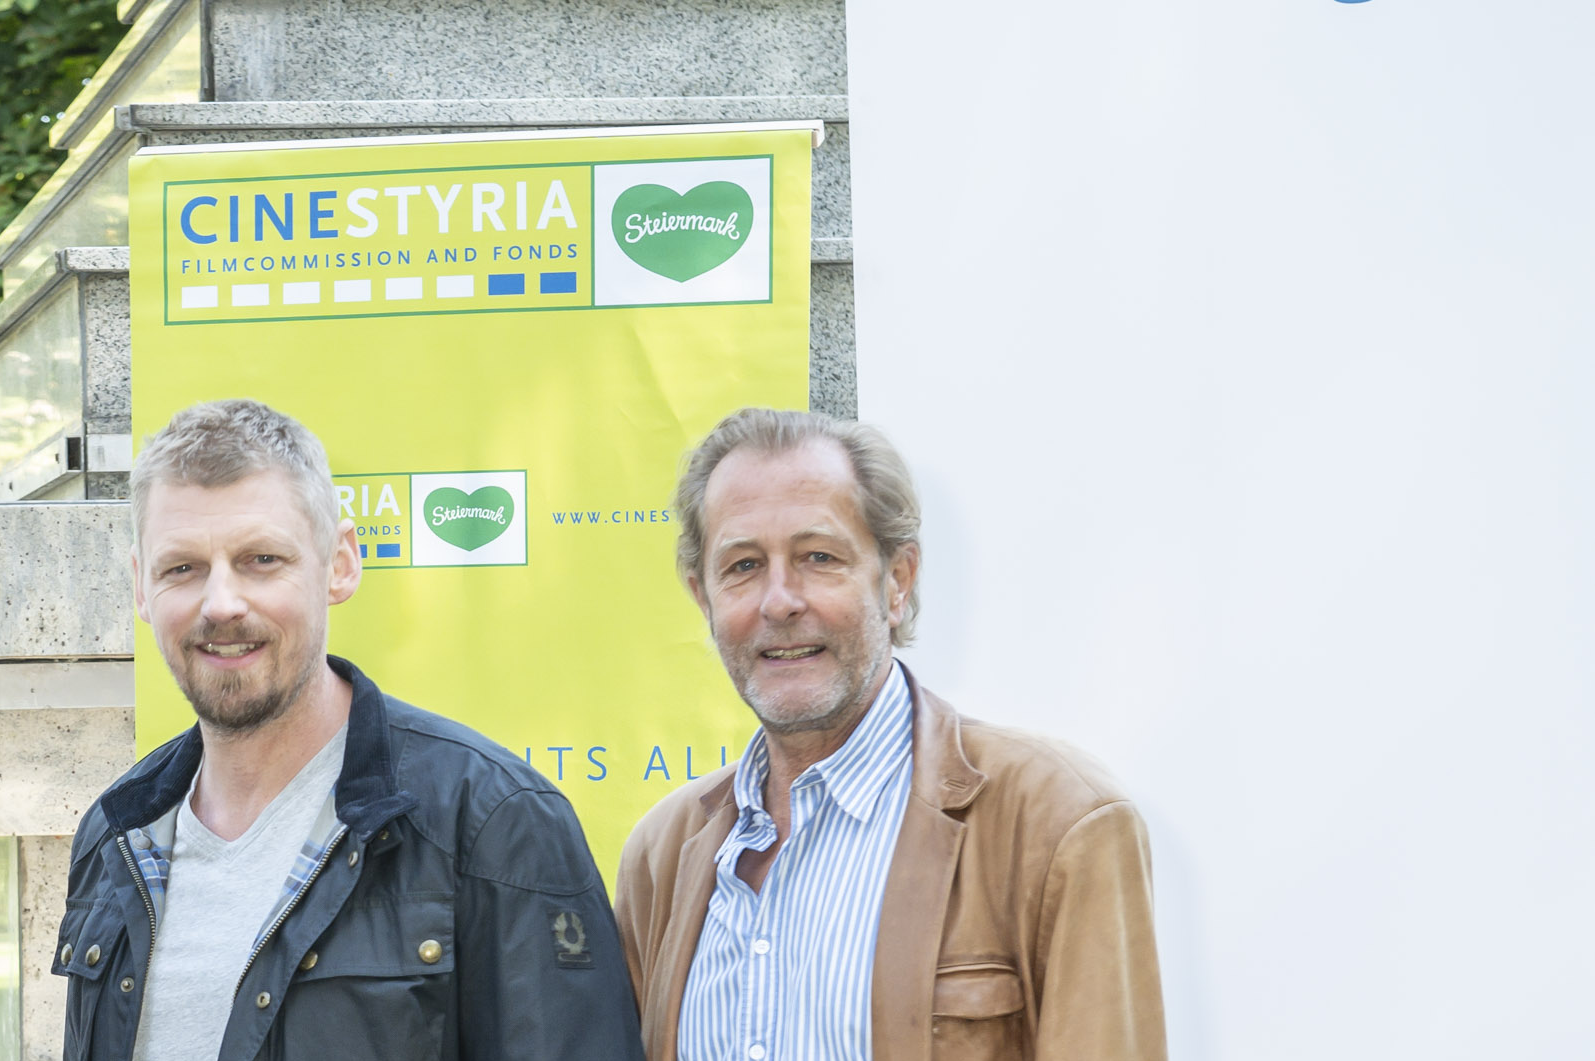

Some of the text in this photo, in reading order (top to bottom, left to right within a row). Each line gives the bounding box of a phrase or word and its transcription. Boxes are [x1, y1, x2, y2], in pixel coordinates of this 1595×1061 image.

[180, 179, 578, 244] CINESTYRIA
[624, 211, 741, 245] Steiermark
[181, 243, 578, 275] FILMCOMMISSION AND FONDS
[431, 505, 507, 526] Steiermark
